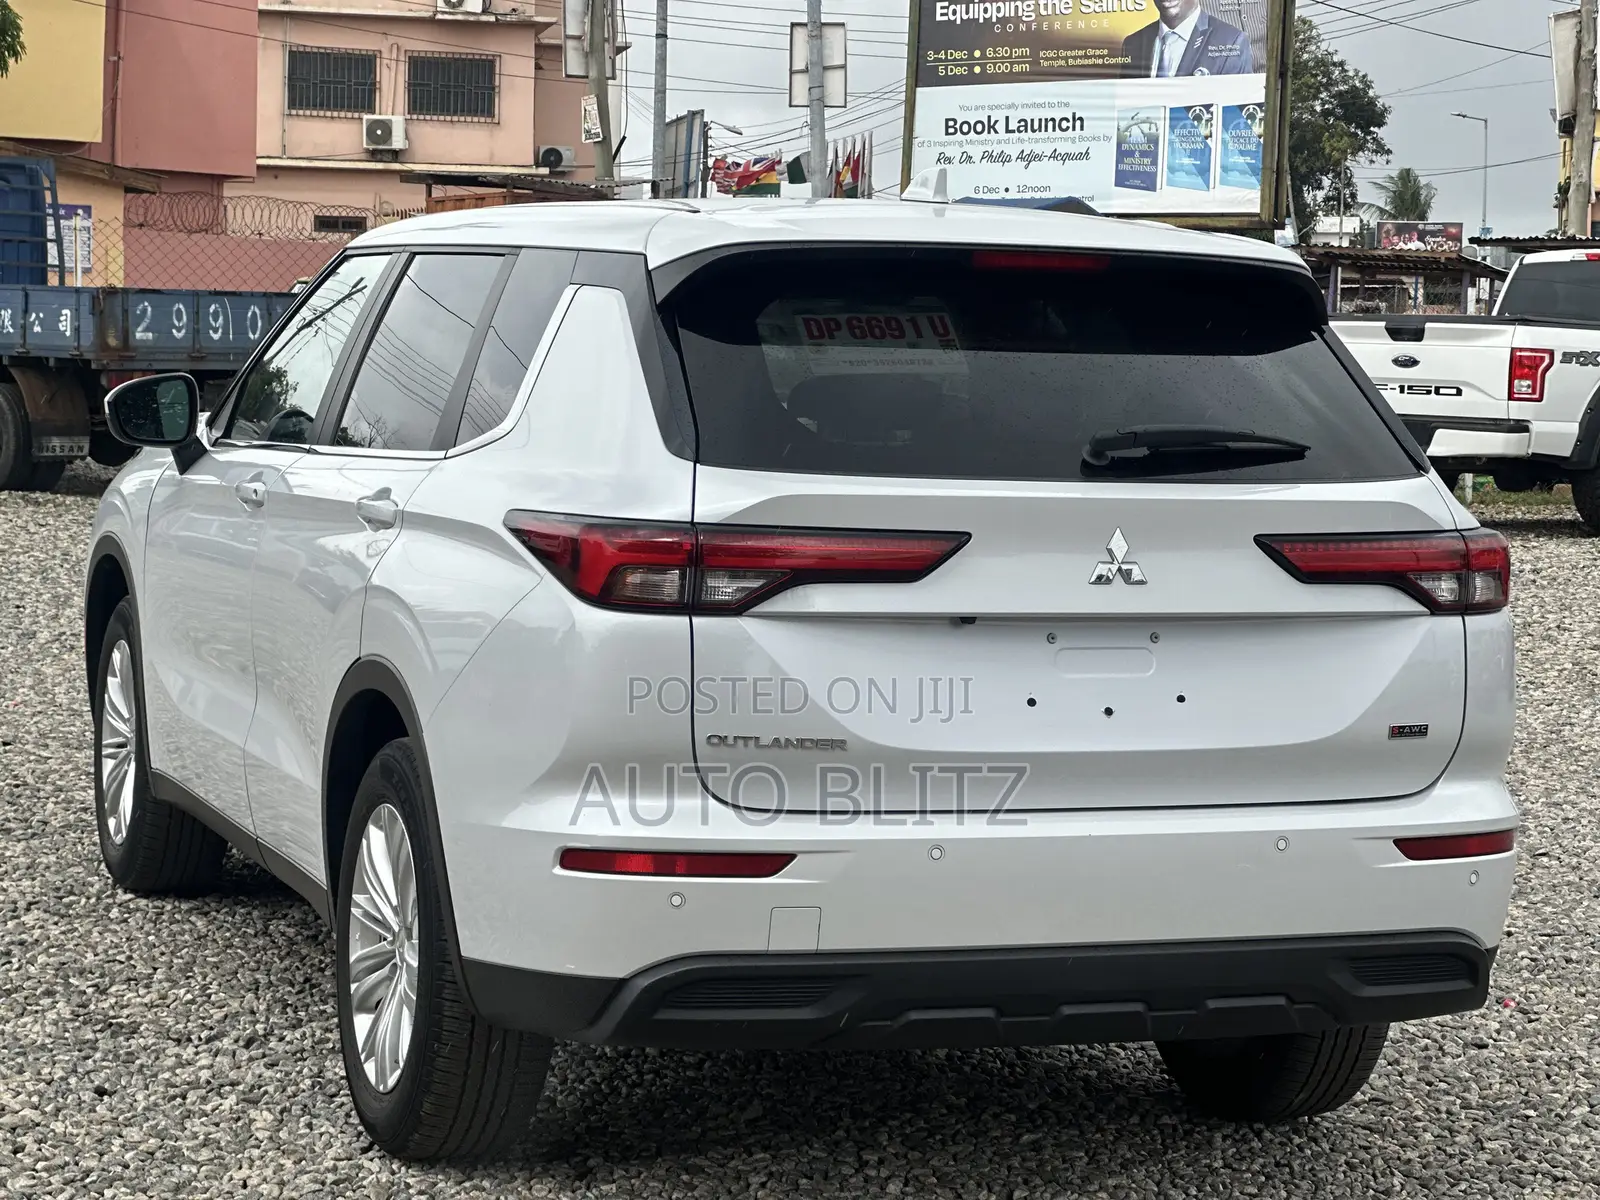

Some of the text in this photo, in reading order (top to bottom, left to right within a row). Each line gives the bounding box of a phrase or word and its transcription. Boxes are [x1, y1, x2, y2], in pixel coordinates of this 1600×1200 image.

[936, 0, 1147, 24] Equipping the Saints
[994, 19, 1109, 32] CONFERENCE
[927, 46, 1030, 60] 3-4 Dec 6.30 pm
[1040, 50, 1057, 58] ICGC
[1040, 56, 1131, 67] Temple, Bubiashie Control
[938, 63, 1030, 75] 5 Dec 9.00 am
[987, 102, 1019, 112] specially
[1020, 101, 1046, 109] invited
[944, 112, 1084, 136] Book Launch
[917, 140, 926, 148] of
[933, 139, 964, 148] Inspiring
[965, 137, 994, 146] Ministry
[1011, 135, 1077, 144] Life-transforming
[1103, 134, 1112, 143] by
[1121, 143, 1155, 151] DYNAMICS
[936, 147, 1091, 169] Rev. Dr. Philip Adjei-Acquah
[1124, 157, 1152, 165] MINISTRY
[974, 184, 1051, 194] 6 Dec 12noon
[802, 315, 951, 340] DP 6691 U
[1392, 725, 1428, 734] S-AWC
[706, 733, 848, 752] OUTLANDER
